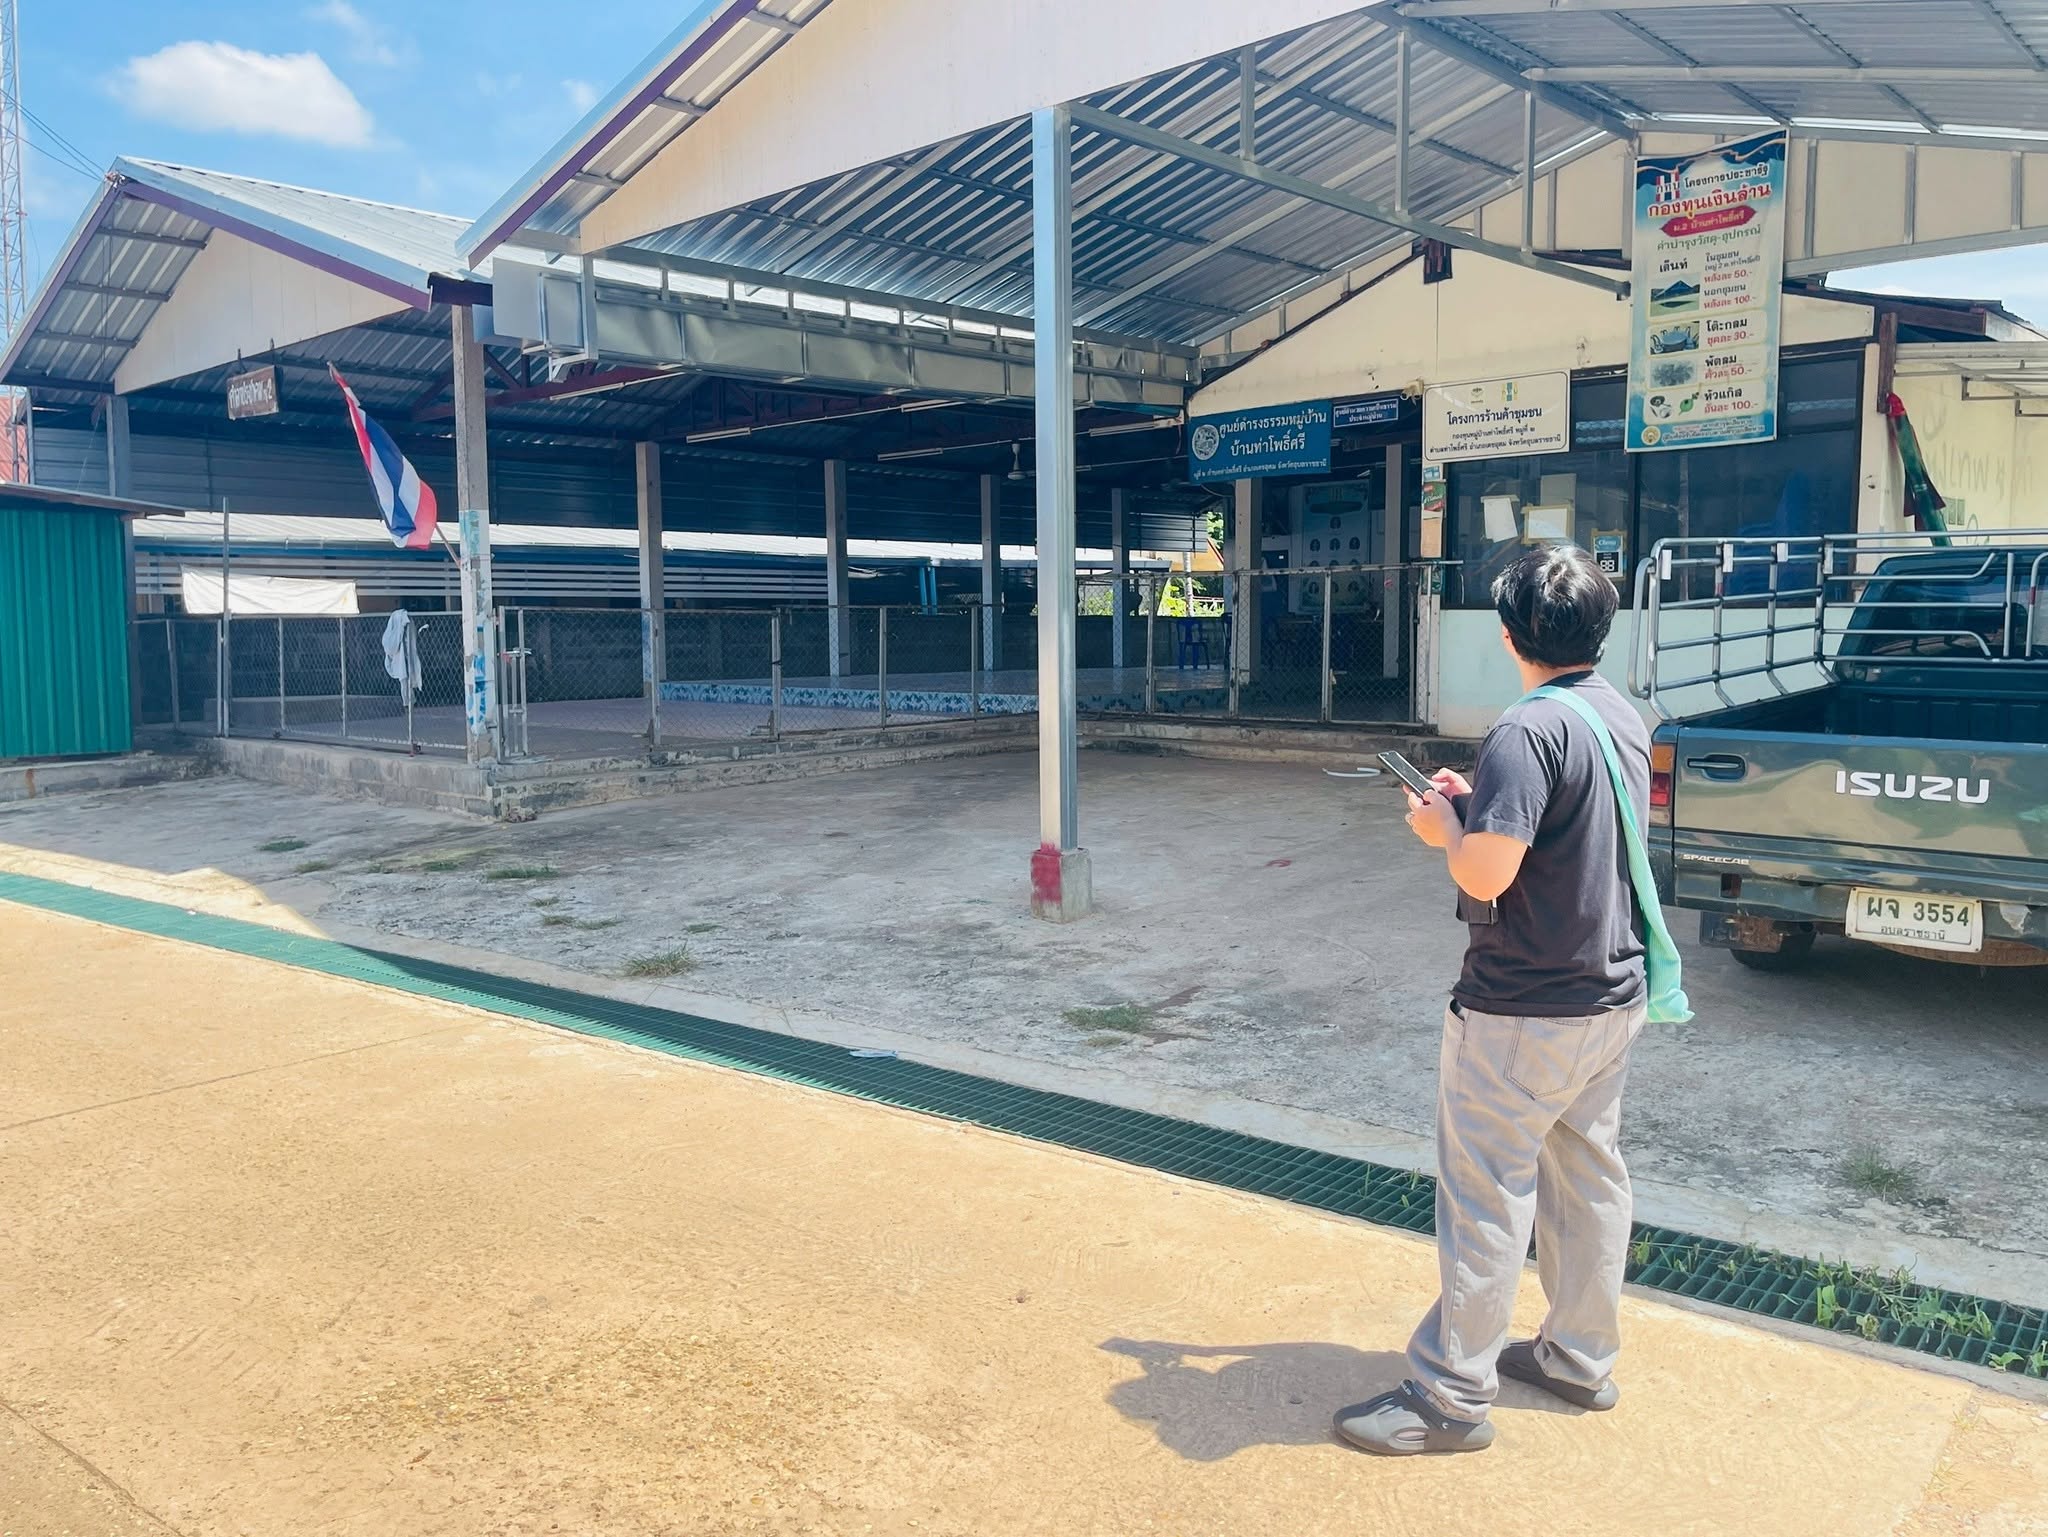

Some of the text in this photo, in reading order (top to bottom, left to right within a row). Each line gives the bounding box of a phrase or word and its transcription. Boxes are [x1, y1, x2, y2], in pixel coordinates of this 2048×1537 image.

[1648, 183, 1771, 218] กองทุนเงินล้าน
[1219, 409, 1327, 439] ศูนย์ดำรงธรรมหมู่บ้าน
[1447, 406, 1542, 425] โครงการร้านค้าชุมชน
[1230, 429, 1306, 457] บ้านท่าโพธิ์ศรี
[1836, 770, 1990, 804] ISUZU
[1682, 853, 1750, 865] SPACECAB
[1867, 896, 1969, 927] ผจ 3554
